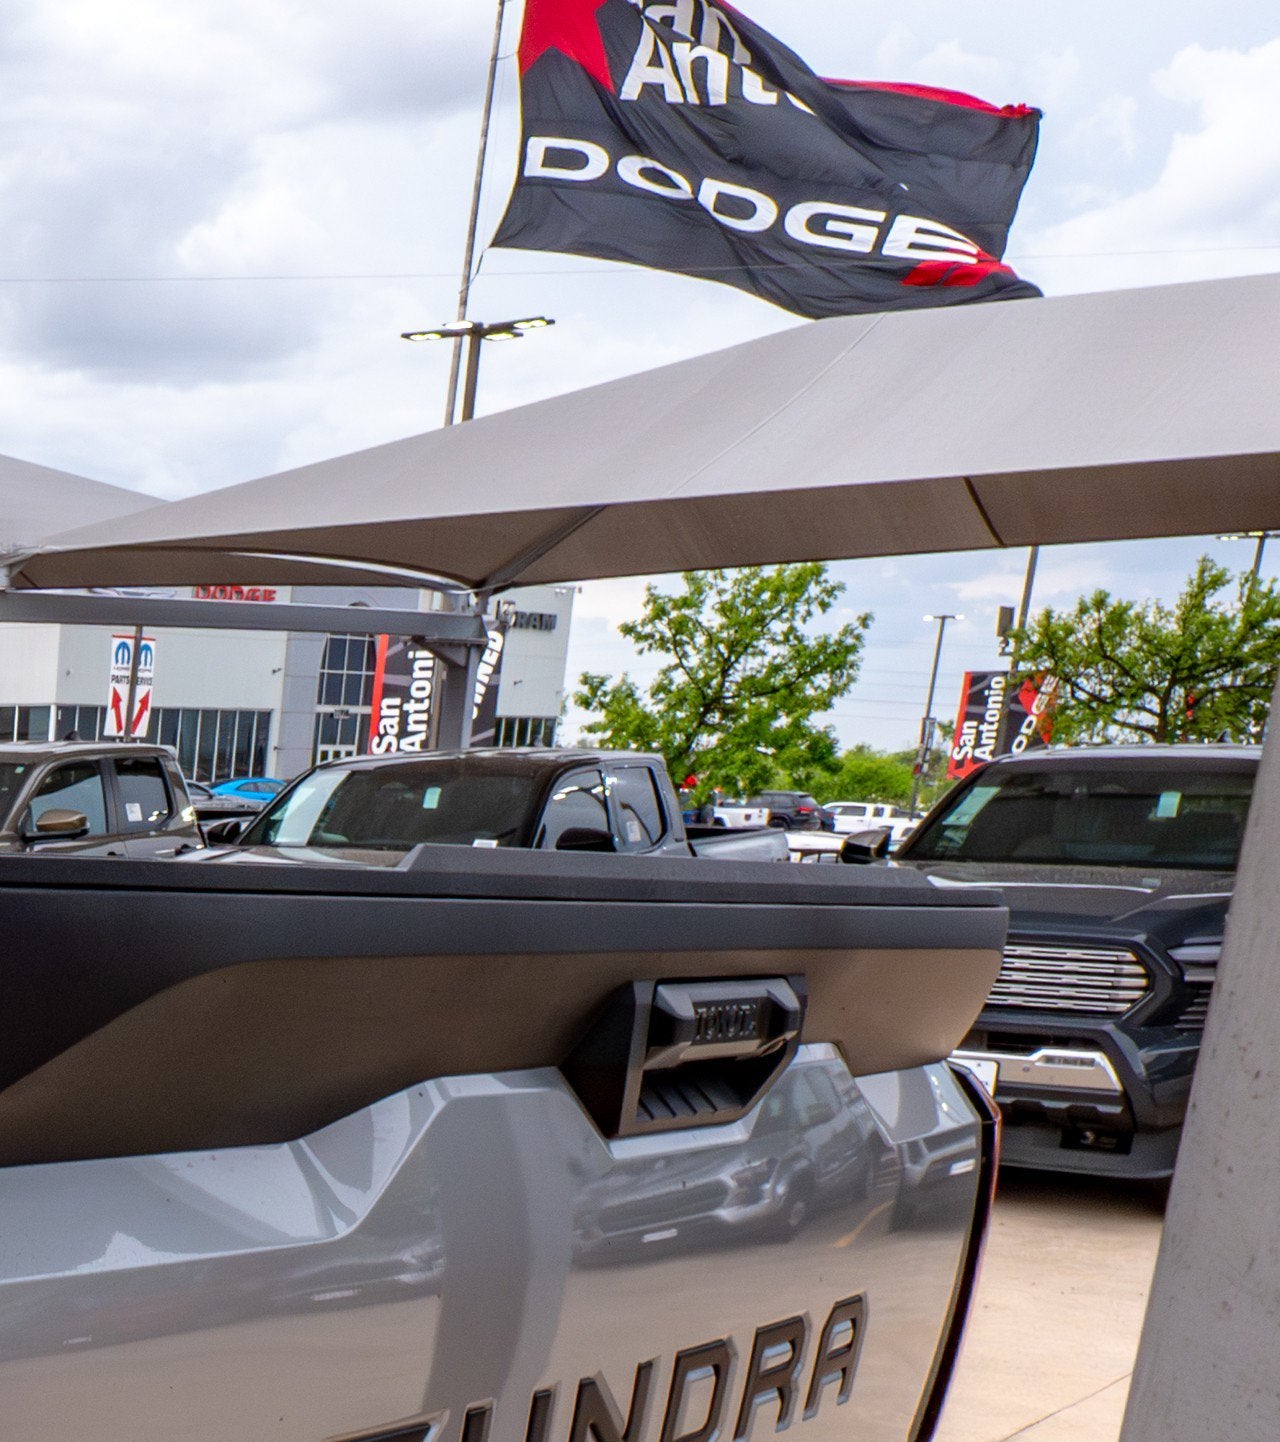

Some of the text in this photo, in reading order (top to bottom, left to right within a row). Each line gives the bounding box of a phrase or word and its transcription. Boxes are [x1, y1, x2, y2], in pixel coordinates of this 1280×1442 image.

[637, 0, 752, 65] an
[619, 15, 817, 117] Ant
[524, 136, 980, 265] DODGE
[195, 585, 277, 603] DODGE
[513, 611, 557, 631] RAM
[371, 696, 402, 754] San
[952, 720, 979, 761] San
[973, 675, 1006, 761] Antonio
[1011, 674, 1059, 754] ODGE
